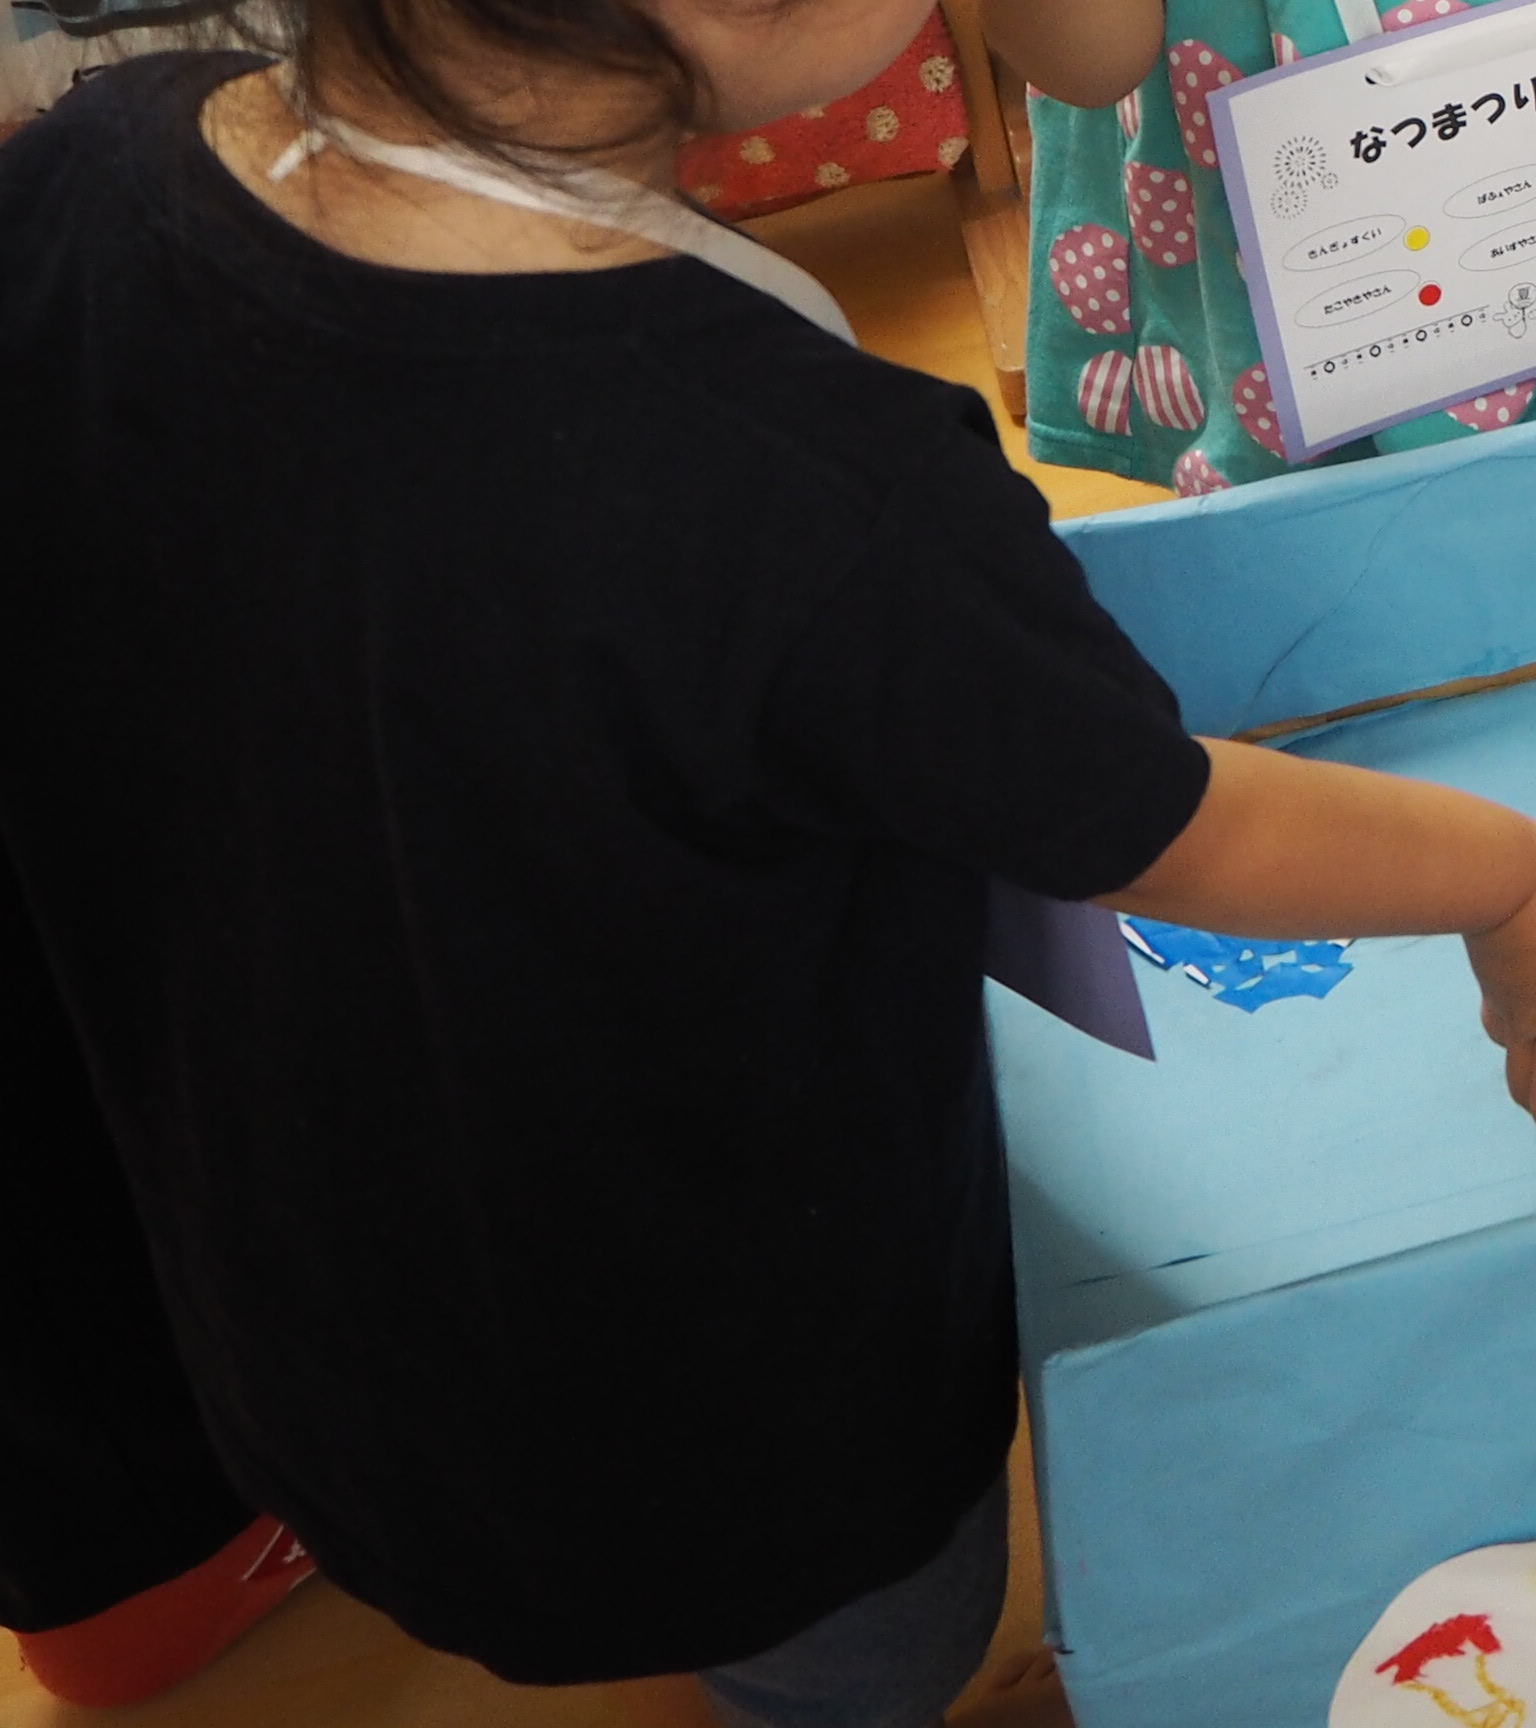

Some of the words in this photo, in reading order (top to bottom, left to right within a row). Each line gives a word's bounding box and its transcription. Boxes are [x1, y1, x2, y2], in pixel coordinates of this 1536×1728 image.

[1323, 285, 1392, 315] たこやきやさん
